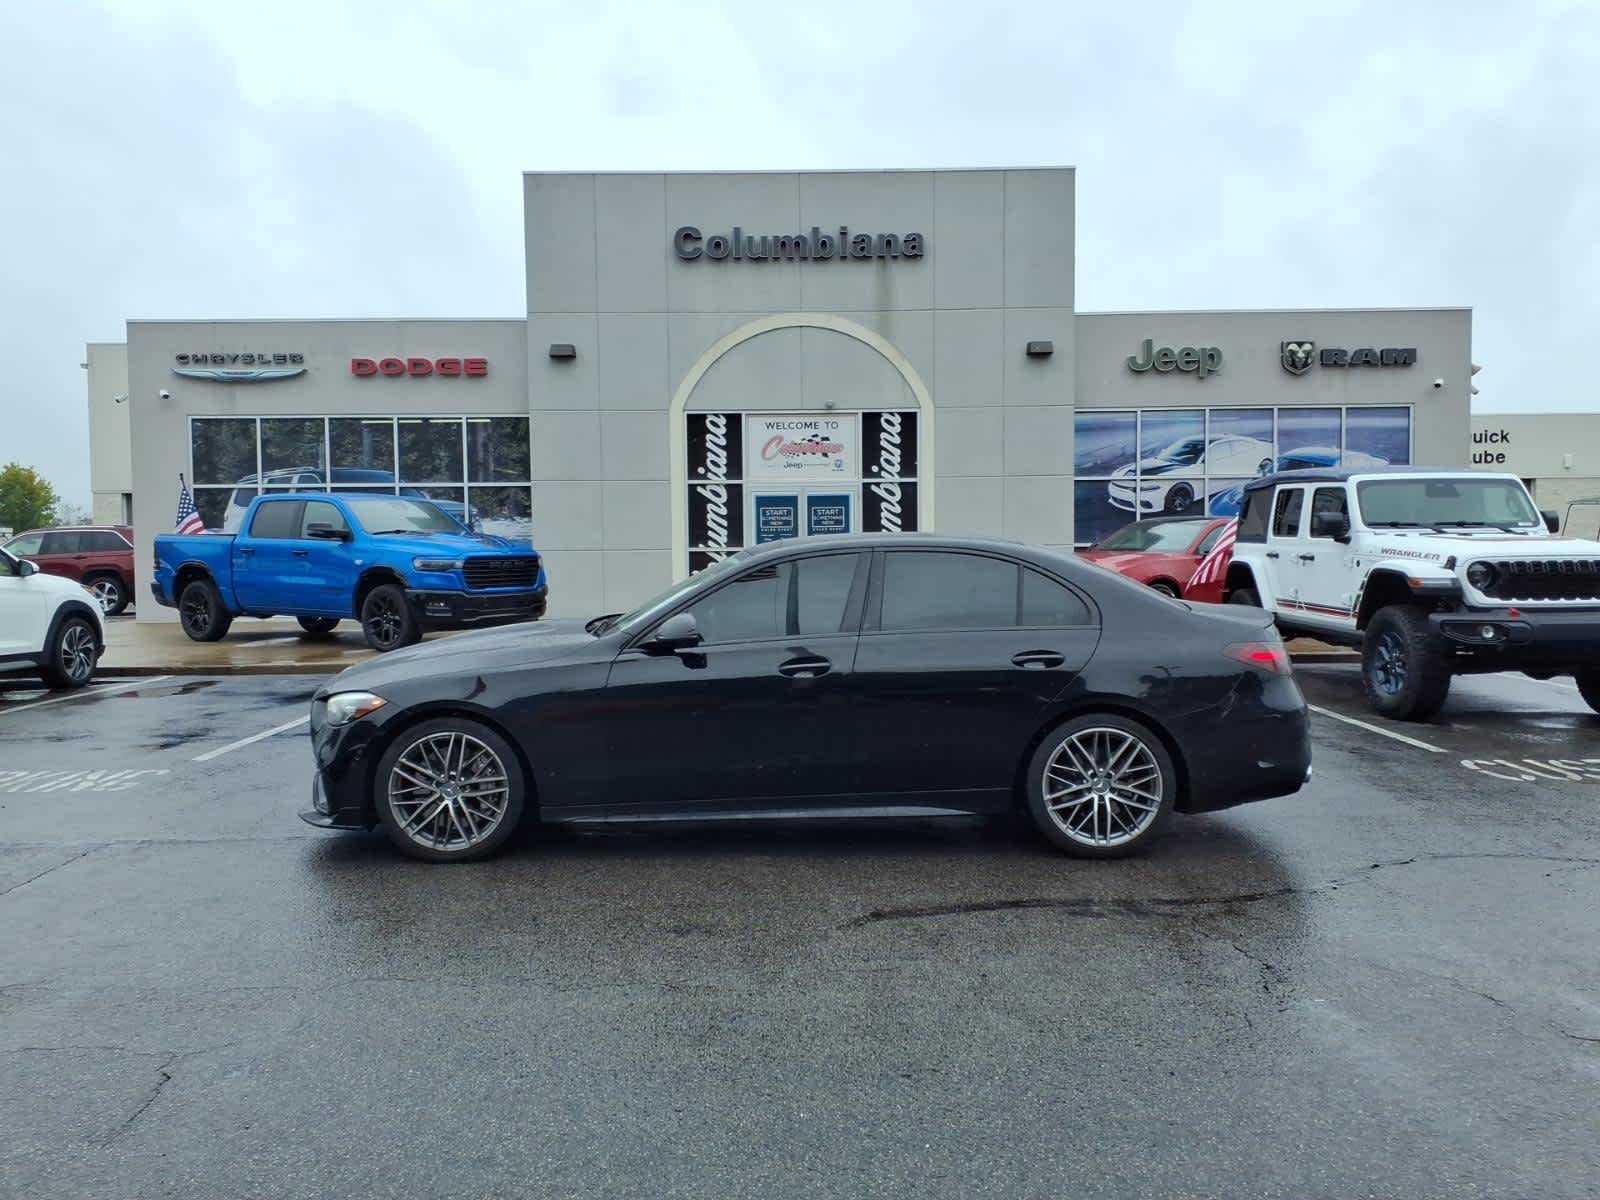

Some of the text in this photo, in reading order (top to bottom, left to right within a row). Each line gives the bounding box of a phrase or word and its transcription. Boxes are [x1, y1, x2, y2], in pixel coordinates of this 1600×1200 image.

[673, 226, 924, 260] Columbiana
[176, 352, 304, 365] CHRYSLER
[1127, 338, 1224, 378] Jeep
[1319, 347, 1417, 367] RAM
[352, 358, 488, 376] DODGE
[765, 422, 839, 430] WELCOME TO
[1472, 429, 1510, 444] uick
[1472, 450, 1505, 464] ube
[871, 412, 903, 533] mbiana
[691, 413, 728, 574] lumbiana
[1380, 547, 1441, 561] WRANGLER
